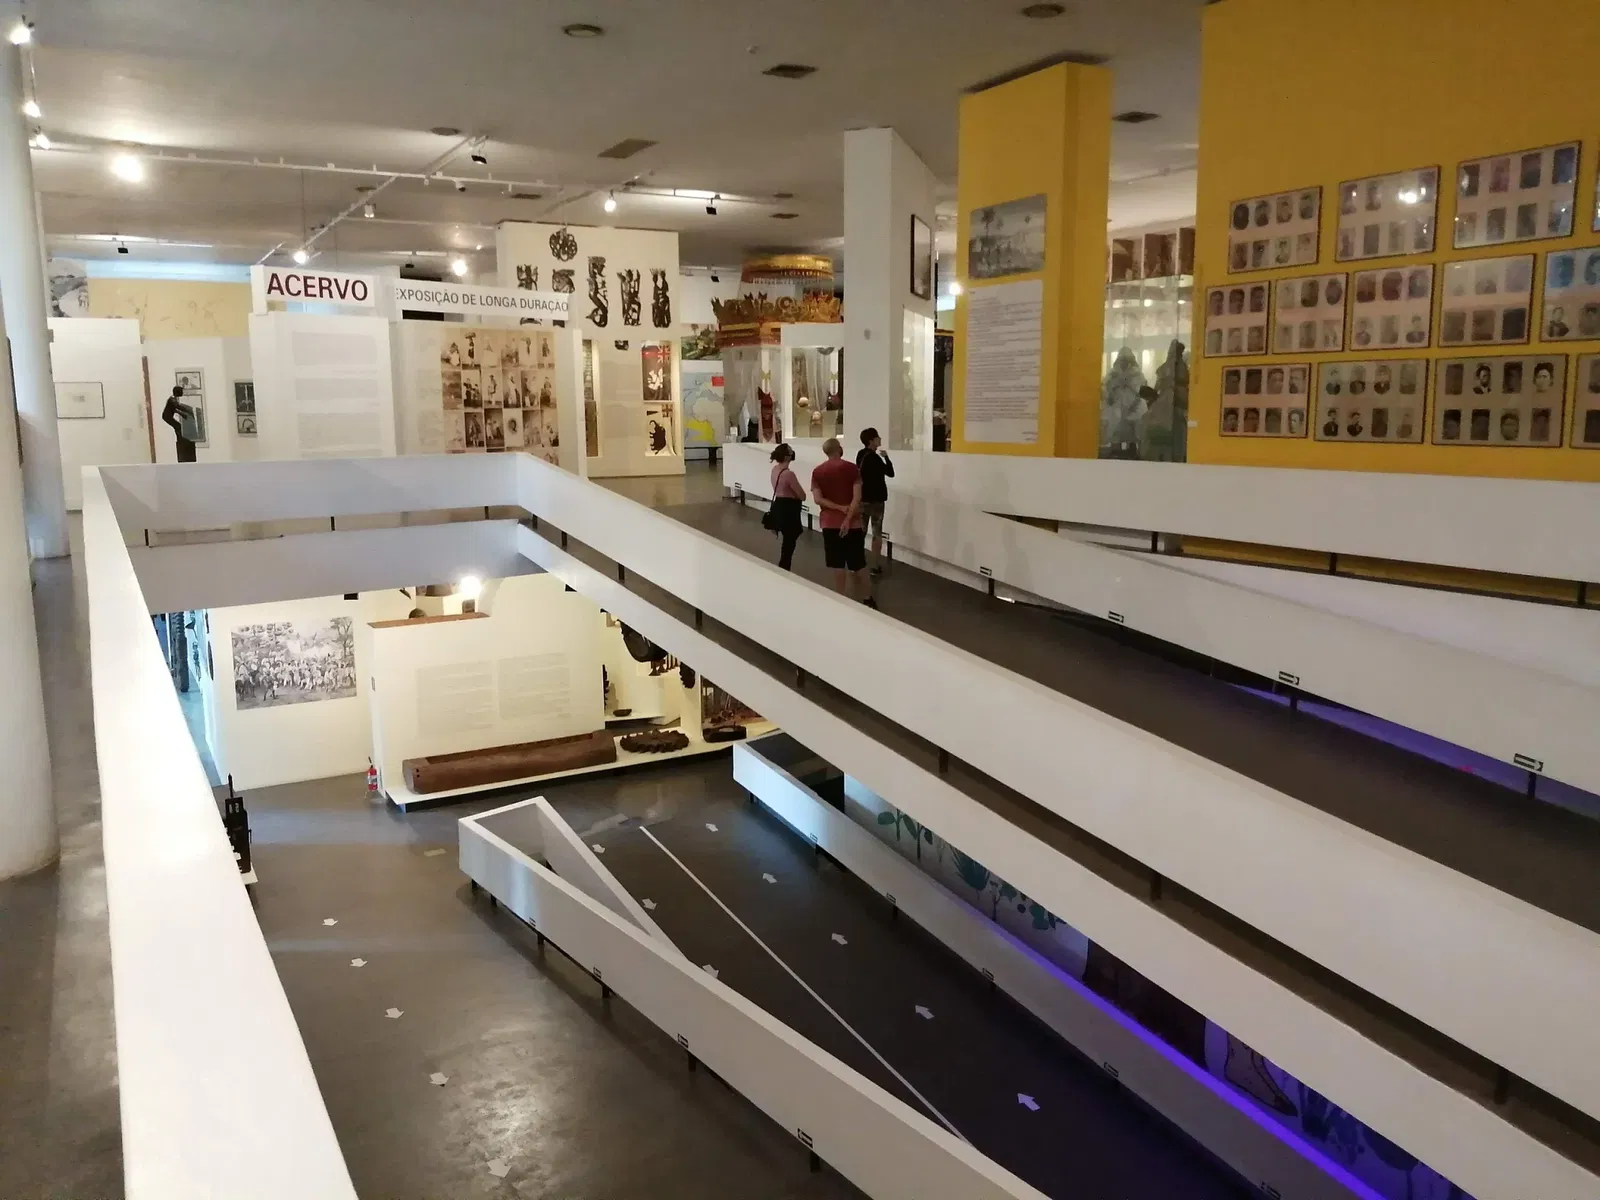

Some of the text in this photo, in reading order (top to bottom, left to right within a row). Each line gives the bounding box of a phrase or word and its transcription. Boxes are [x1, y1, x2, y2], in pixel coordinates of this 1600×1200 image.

[267, 273, 368, 301] ACERVO
[462, 293, 477, 305] DE
[480, 295, 517, 308] LONGA
[520, 298, 569, 313] DURAÇÃO
